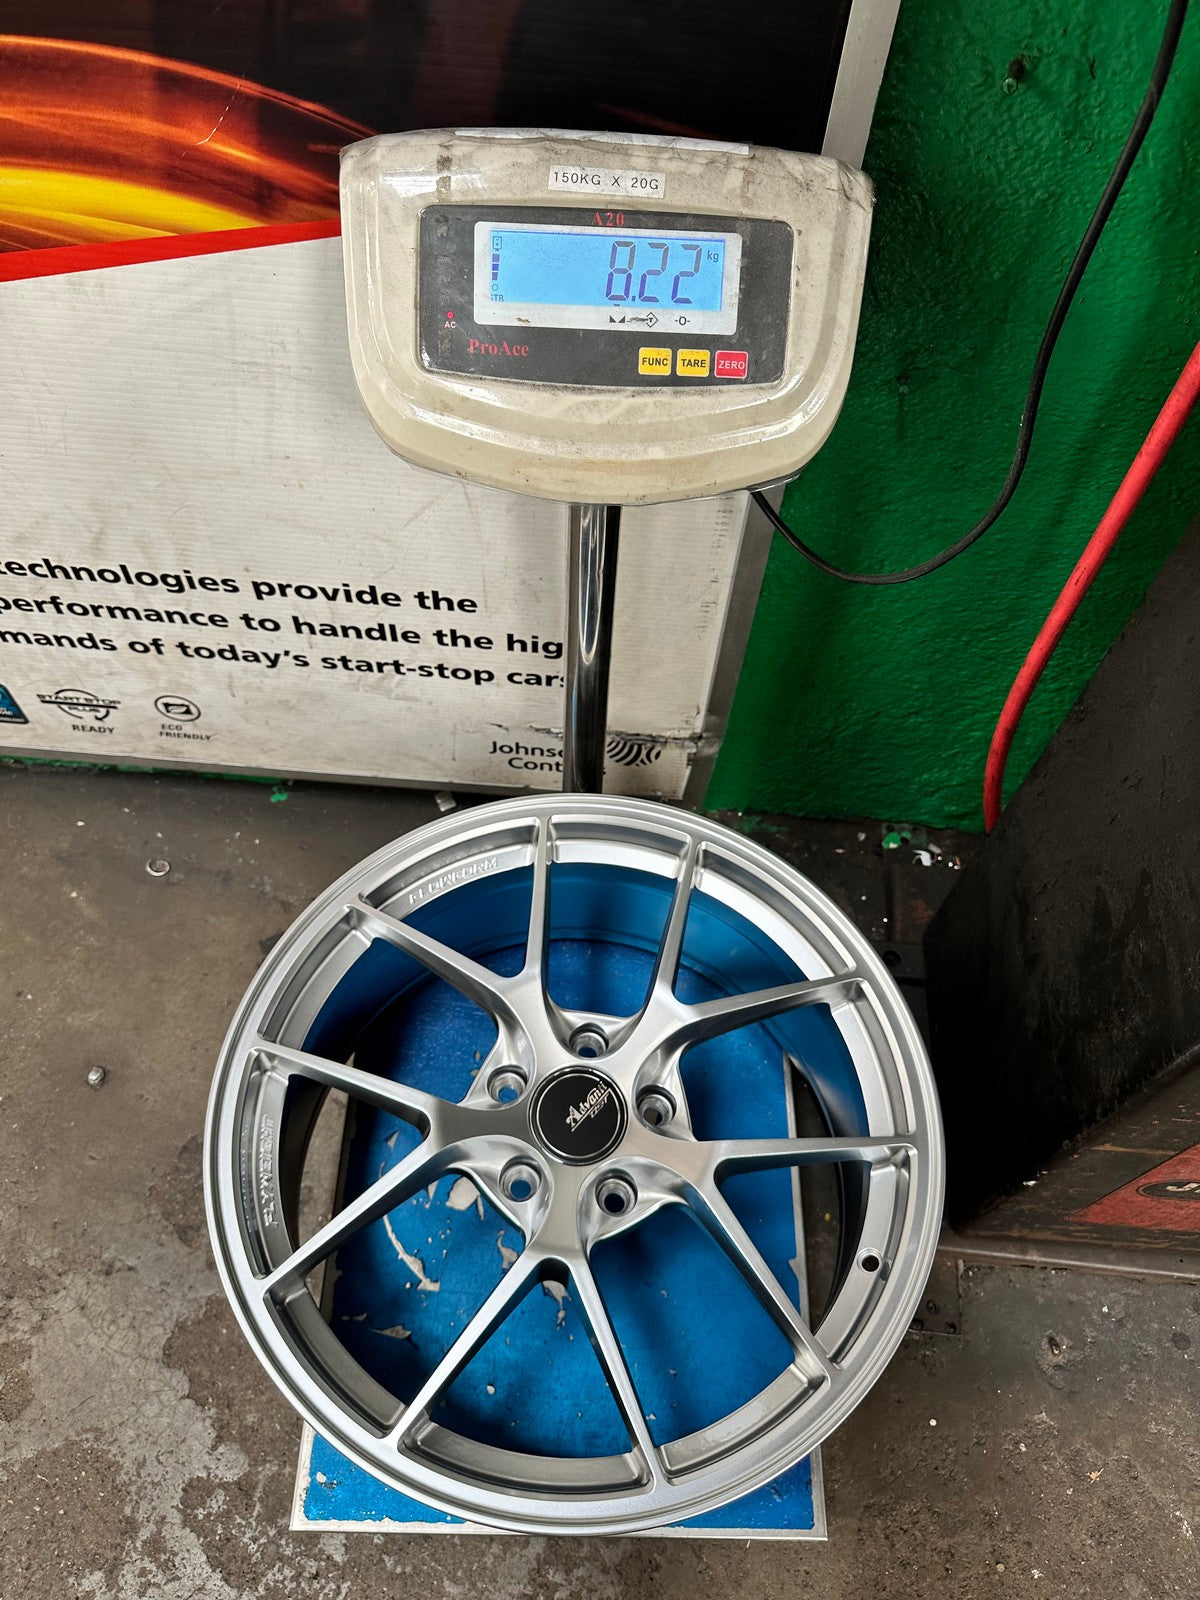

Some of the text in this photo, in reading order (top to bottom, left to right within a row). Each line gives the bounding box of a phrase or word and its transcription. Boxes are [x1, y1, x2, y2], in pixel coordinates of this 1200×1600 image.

[554, 171, 601, 186] 150KG
[630, 177, 659, 190] 20G
[591, 211, 625, 227] A20
[605, 241, 720, 304] 8.22 kg
[444, 321, 456, 329] AC
[467, 338, 529, 356] ProAce
[641, 357, 669, 367] FUNC
[681, 358, 707, 368] TARE
[718, 360, 746, 371] ZERO
[251, 580, 402, 607] provide
[413, 590, 478, 613] the
[239, 613, 282, 633] to
[291, 615, 421, 644] handle
[432, 628, 494, 650] the
[128, 638, 165, 655] of
[175, 641, 310, 669] today's
[321, 654, 495, 686] start-stop
[72, 724, 115, 734] READY
[159, 731, 212, 741] FRIENDLY
[565, 1080, 608, 1127] Advanti
